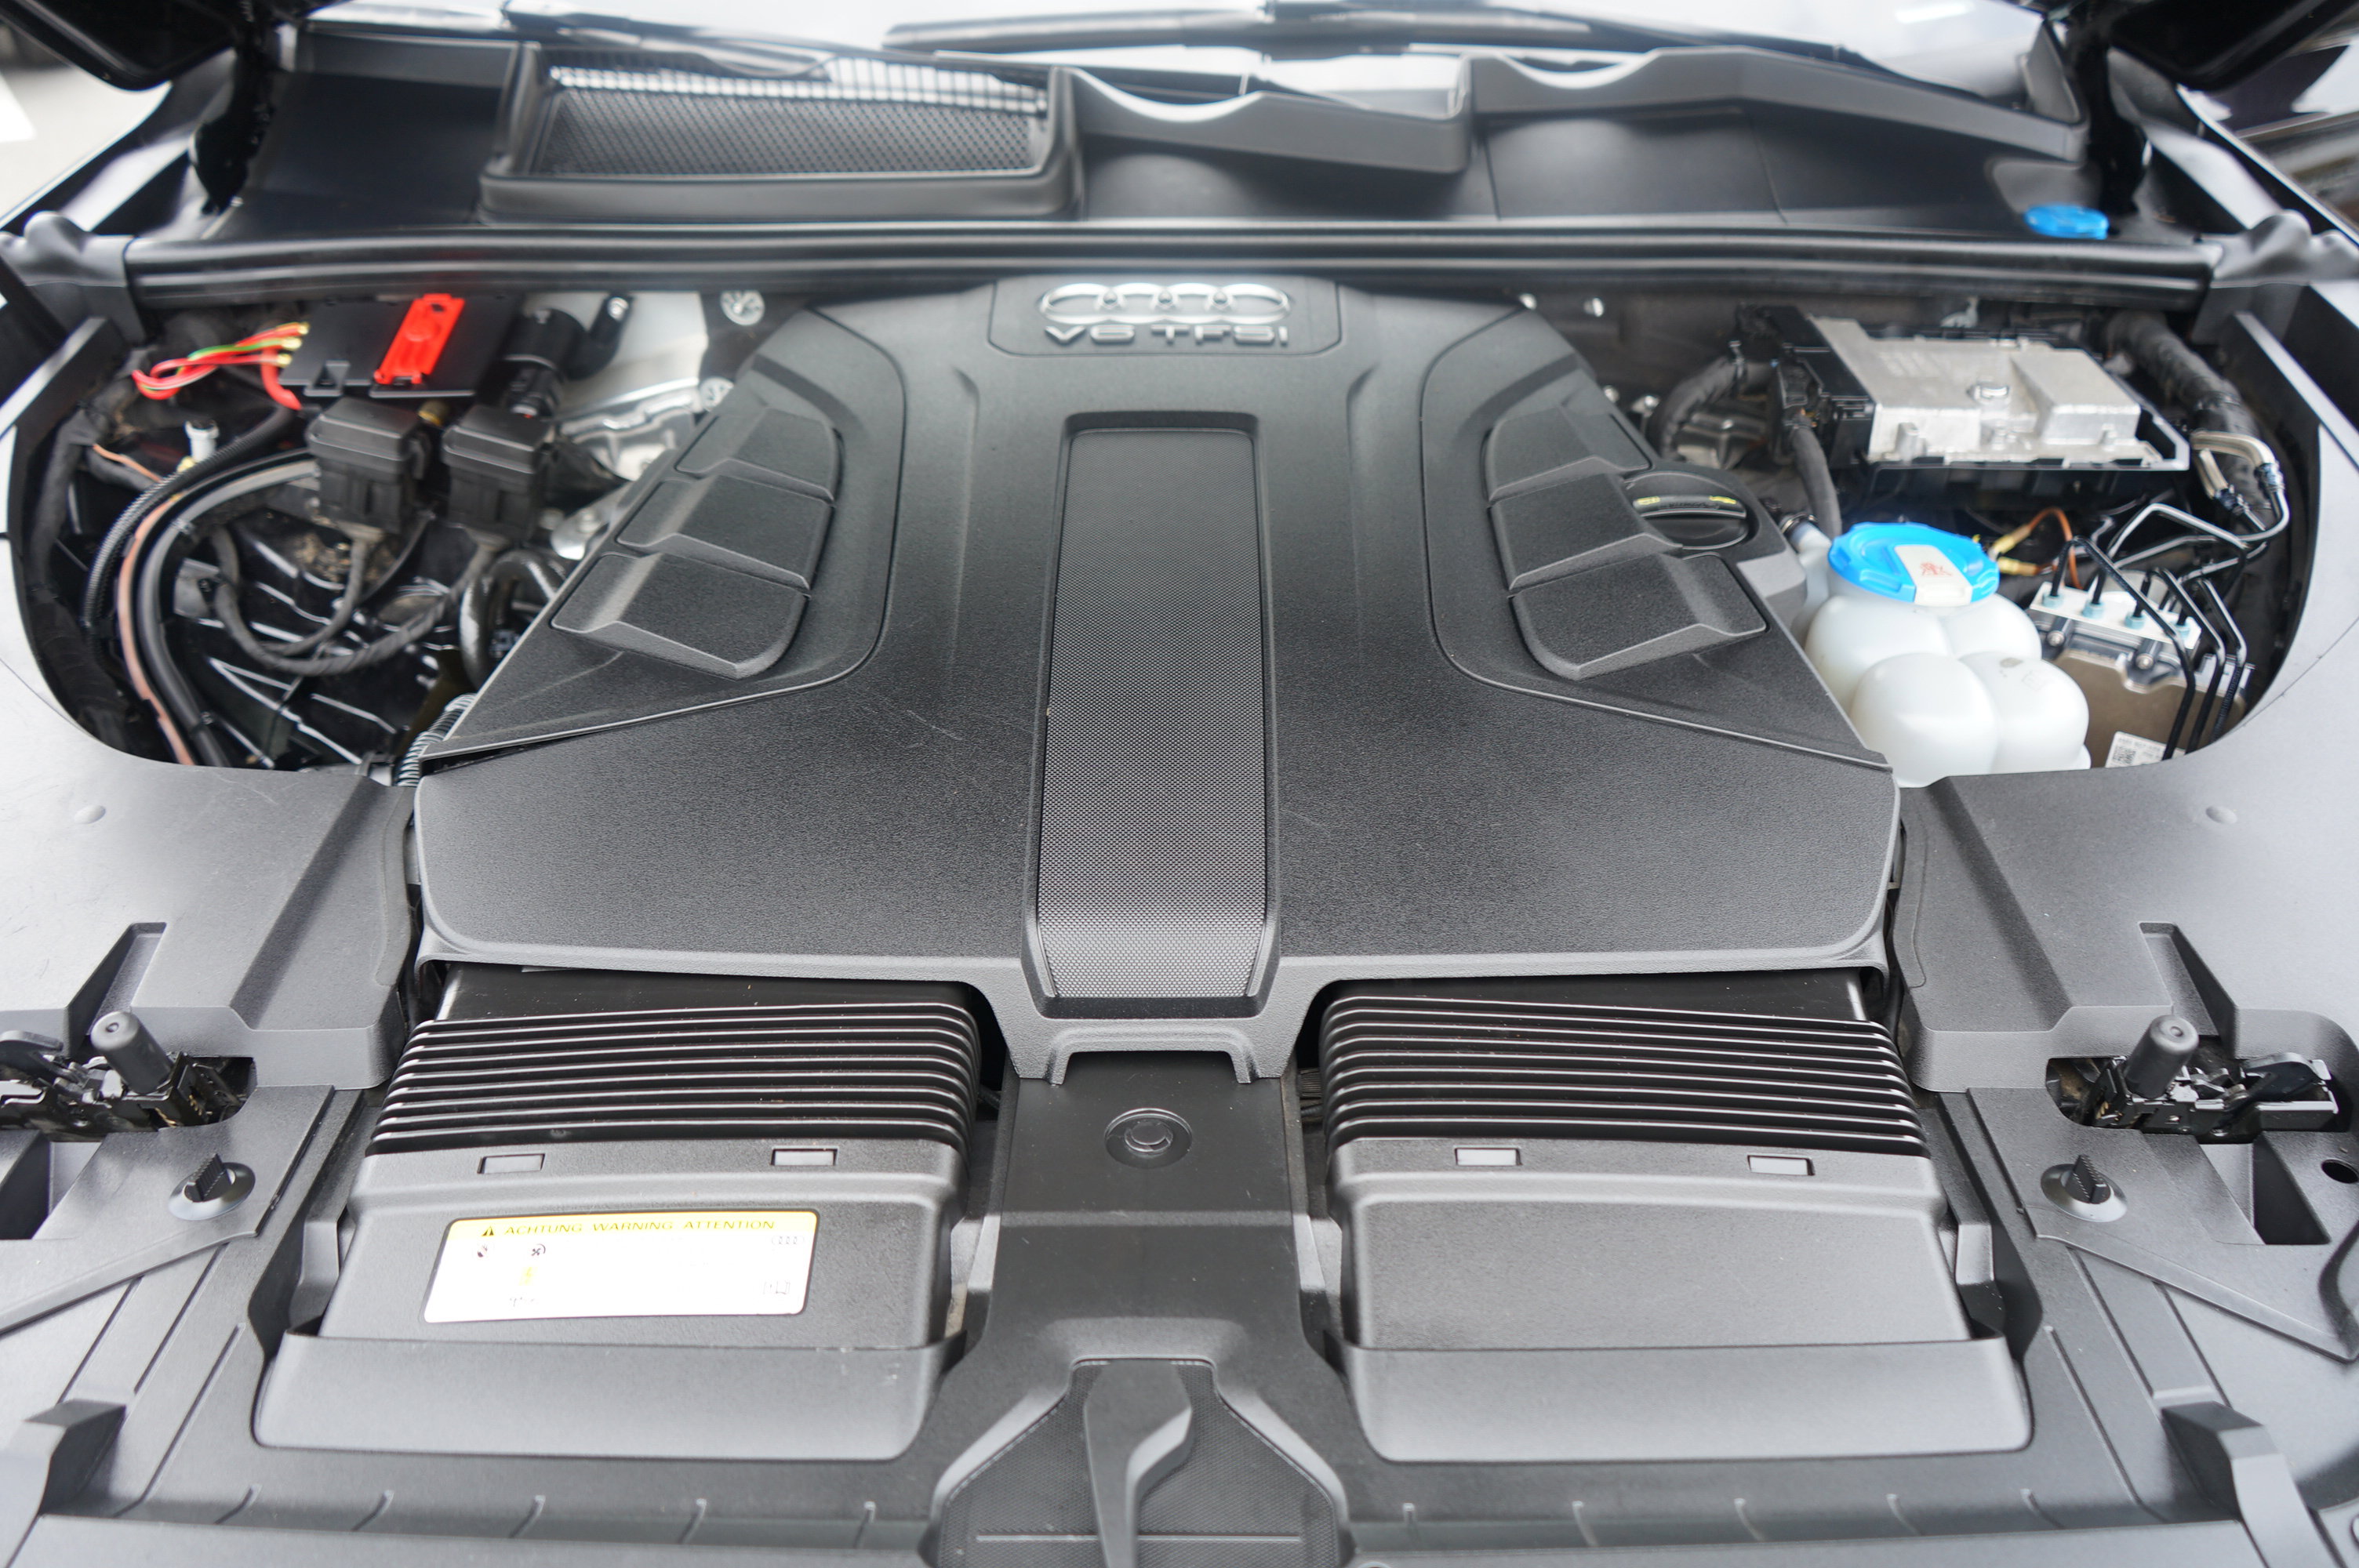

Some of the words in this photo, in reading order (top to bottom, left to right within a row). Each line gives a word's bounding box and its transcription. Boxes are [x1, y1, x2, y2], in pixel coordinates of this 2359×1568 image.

[1044, 324, 1136, 346] V6
[1150, 323, 1289, 347] TFSI
[503, 1223, 583, 1236] ACHTUNG
[592, 1221, 674, 1232] WARNING
[683, 1220, 776, 1230] ATTENTION
